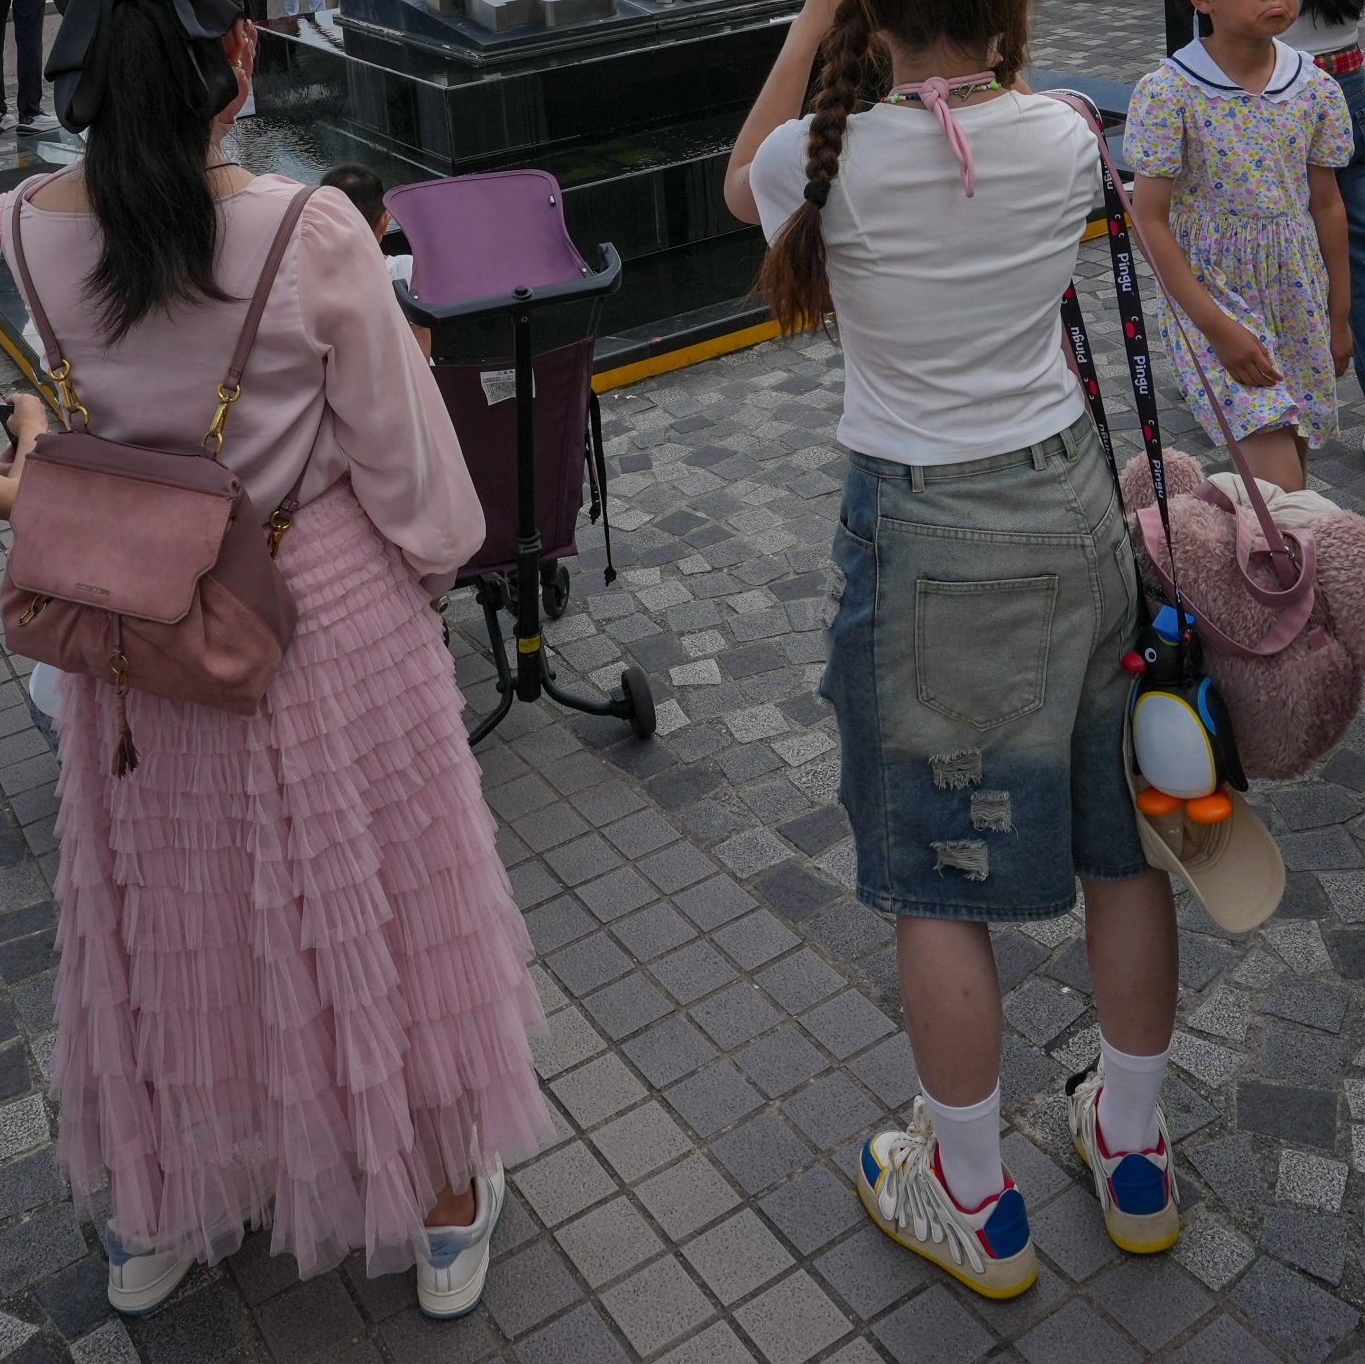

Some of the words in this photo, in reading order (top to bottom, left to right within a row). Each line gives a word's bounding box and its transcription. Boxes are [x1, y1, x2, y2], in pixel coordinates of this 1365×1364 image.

[1117, 252, 1132, 292] Pingu
[1070, 326, 1088, 364] Pingu
[1133, 355, 1148, 395] Pingu
[1152, 459, 1164, 499] Pingu
